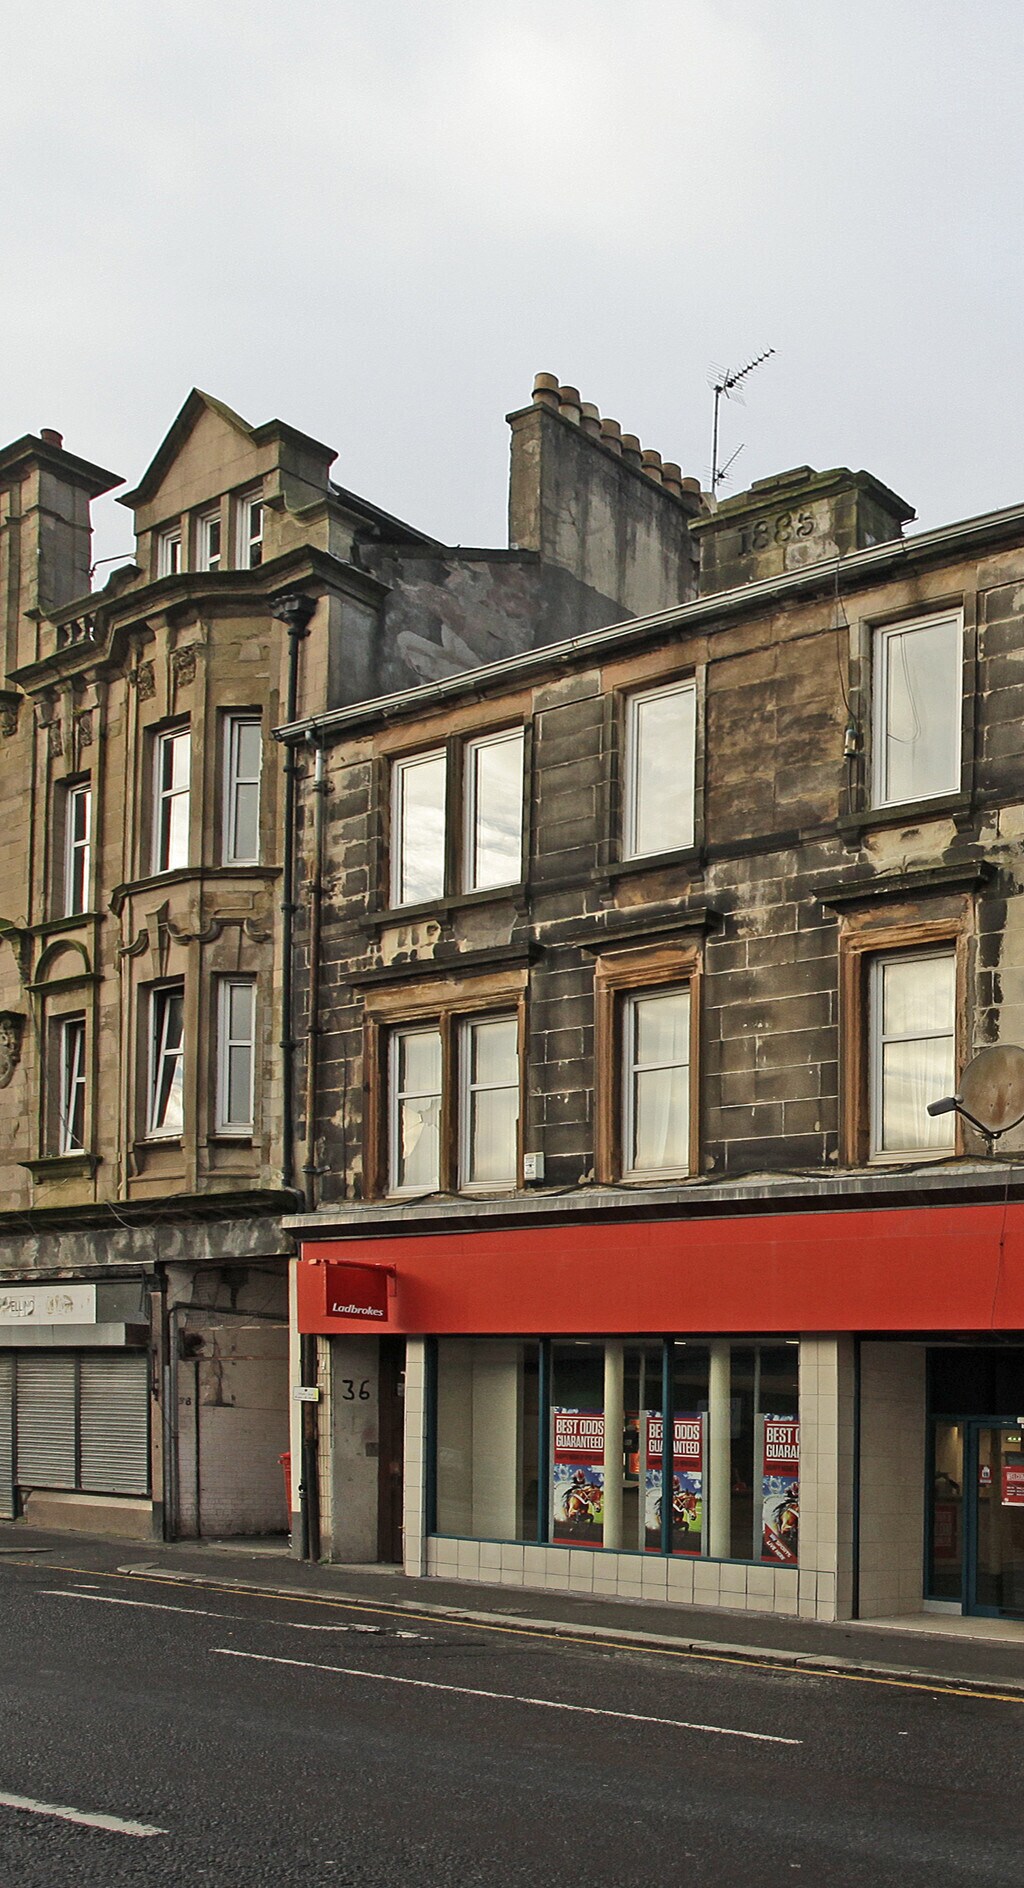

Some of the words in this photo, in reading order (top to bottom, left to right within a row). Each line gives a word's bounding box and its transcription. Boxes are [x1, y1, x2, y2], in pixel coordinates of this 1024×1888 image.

[738, 512, 814, 556] 1885
[332, 1303, 383, 1316] Ladbrokes
[342, 1380, 370, 1400] 36
[556, 1419, 578, 1434] BEST
[580, 1420, 604, 1435] ODDS
[674, 1424, 700, 1440] ODDS
[766, 1427, 793, 1443] BEST
[556, 1435, 603, 1448] GUARANTEED
